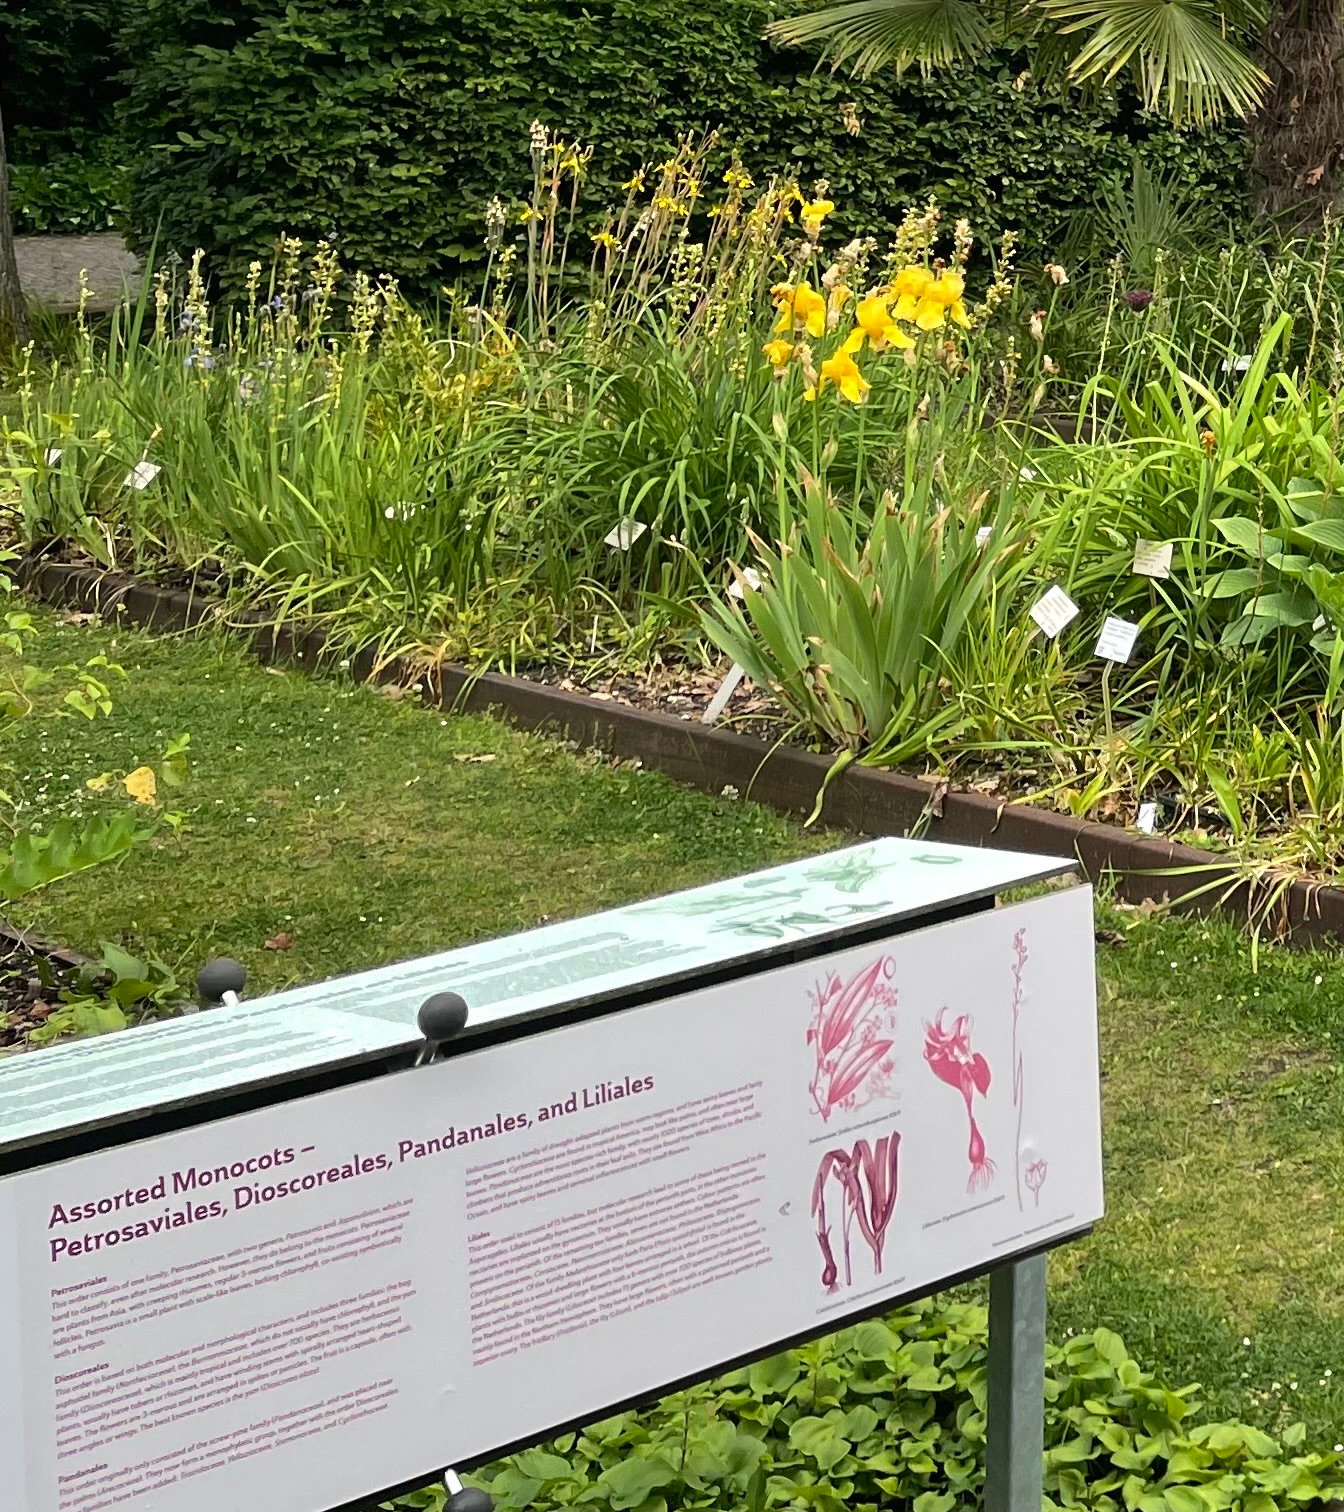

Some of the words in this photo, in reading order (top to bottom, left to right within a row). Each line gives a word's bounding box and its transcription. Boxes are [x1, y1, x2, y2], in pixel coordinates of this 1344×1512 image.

[50, 1201, 227, 1261] Petrosaviales,
[234, 1154, 392, 1209] Dioscoreales,
[399, 1114, 532, 1162] Pandanales,
[539, 1092, 577, 1121] and
[583, 1077, 653, 1108] Liliales
[49, 1176, 166, 1229] Assorted
[172, 1149, 294, 1194] Monocots
[51, 1274, 106, 1297] Petrosaviales
[54, 1361, 108, 1384] Dioscoreales
[58, 1460, 107, 1484] Pandanales
